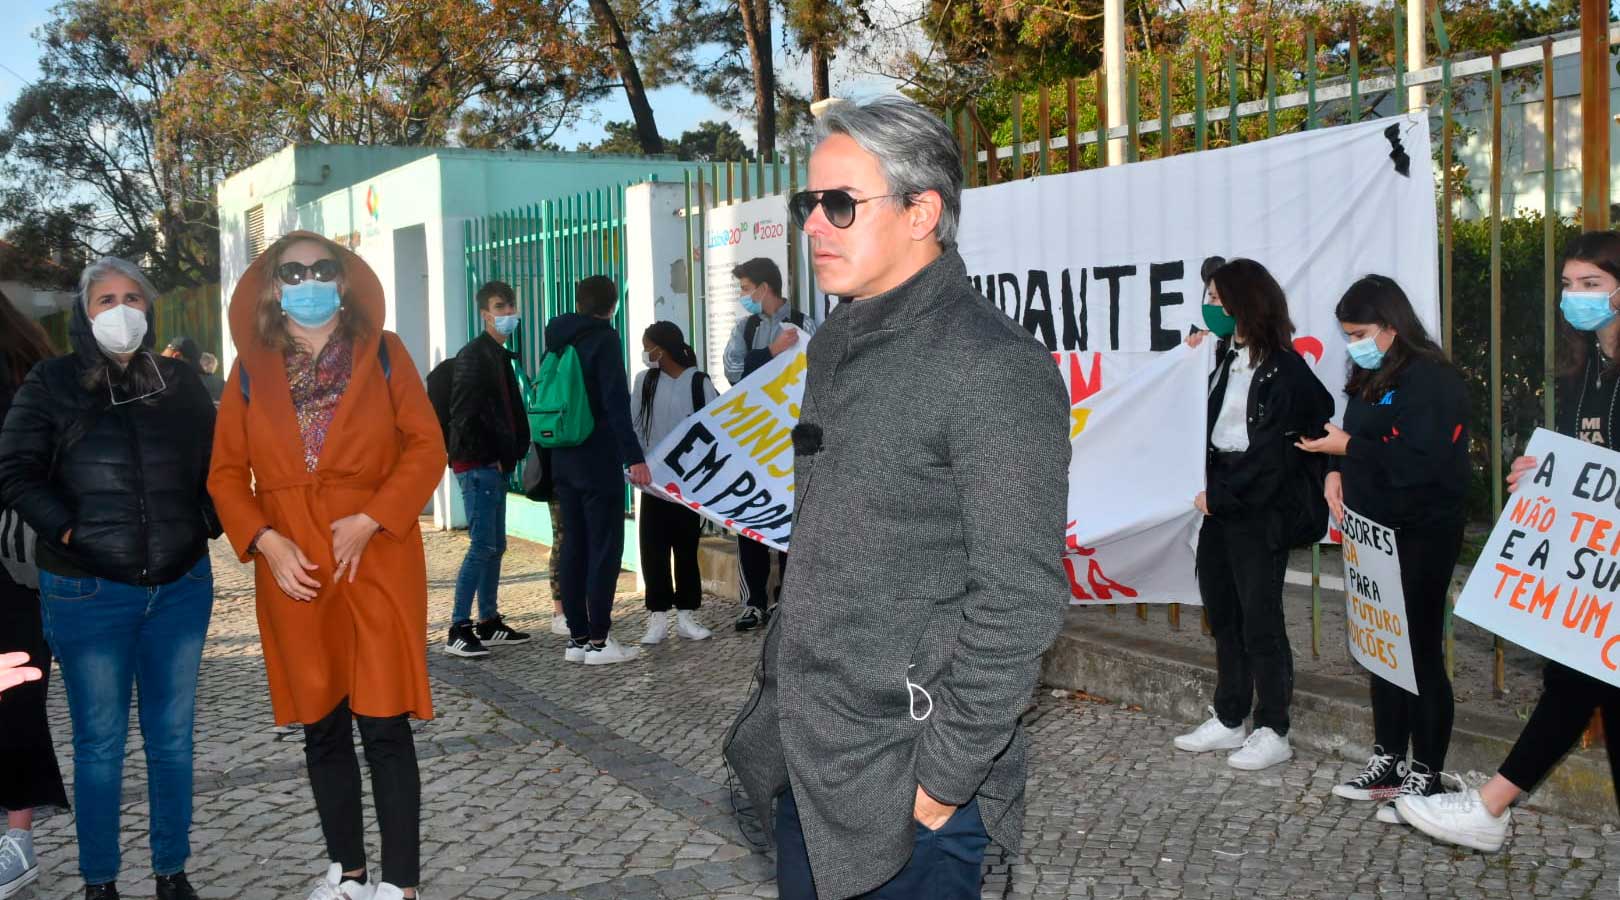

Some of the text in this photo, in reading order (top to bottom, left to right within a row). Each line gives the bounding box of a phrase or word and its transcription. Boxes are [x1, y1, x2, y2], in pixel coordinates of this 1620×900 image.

[760, 223, 784, 240] 2020
[709, 391, 796, 491] MINI
[1580, 431, 1605, 444] KA
[1582, 417, 1601, 430] MI
[664, 422, 732, 493] EM
[1533, 452, 1555, 488] A
[1341, 510, 1393, 556] SSORES
[1510, 495, 1556, 533] NÃO
[1499, 529, 1526, 560] E
[1527, 538, 1550, 570] A
[1349, 567, 1381, 604] PARA
[1494, 563, 1613, 639] TEM UM
[1352, 595, 1403, 637] FUTURO
